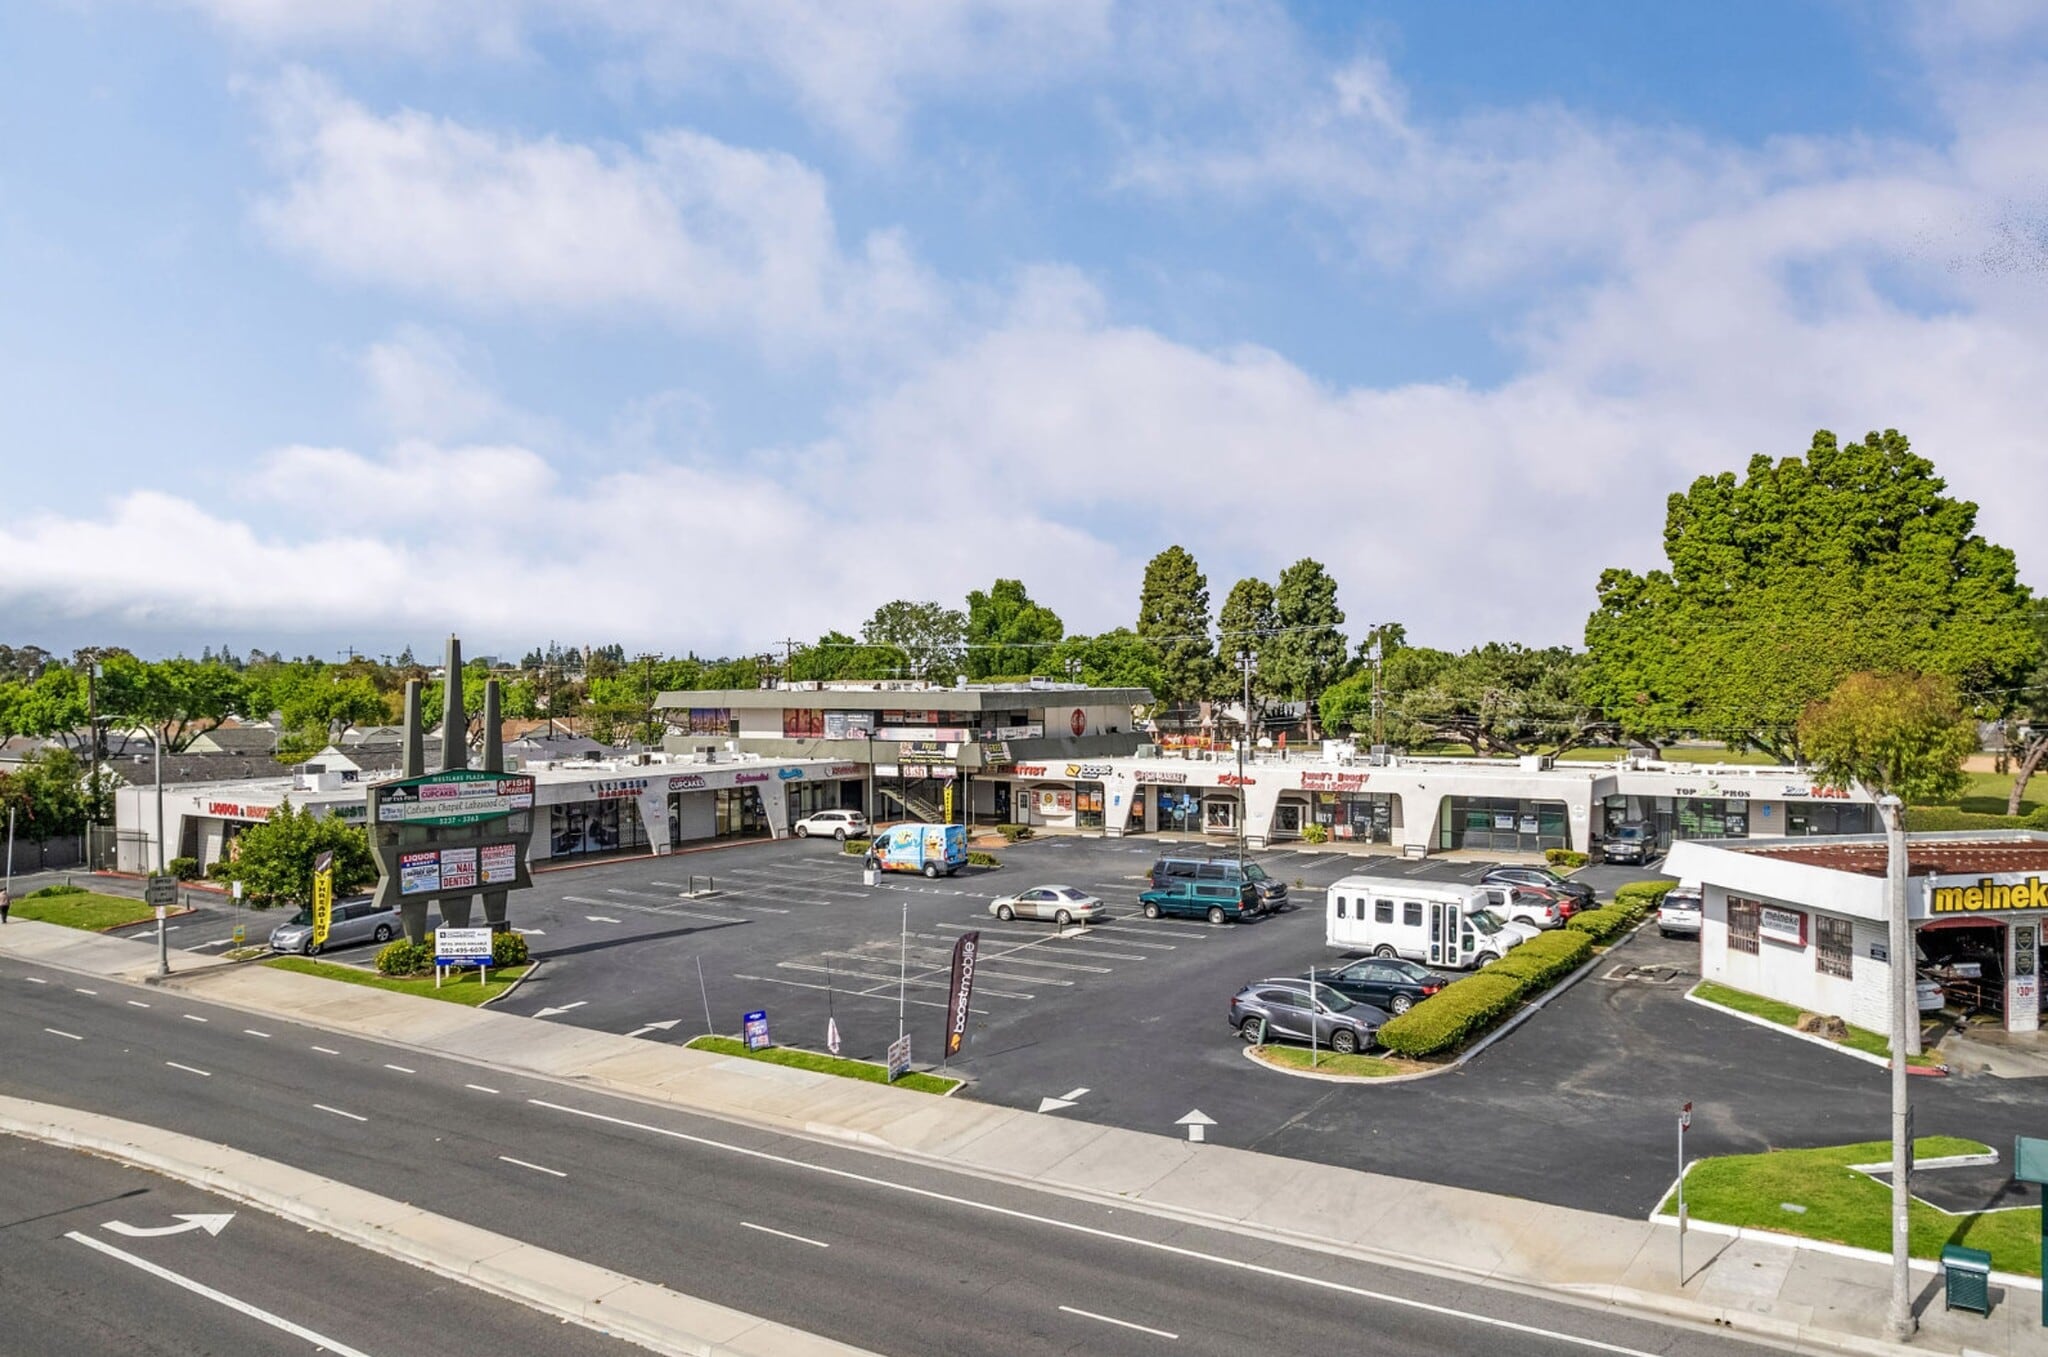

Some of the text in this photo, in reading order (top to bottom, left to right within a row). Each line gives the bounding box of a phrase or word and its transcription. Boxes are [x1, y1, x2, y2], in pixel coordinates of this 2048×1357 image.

[466, 774, 486, 782] PLAZA
[506, 780, 531, 790] FISH
[420, 789, 458, 799] CUPCAKES
[507, 788, 530, 797] MARKET
[1676, 788, 1751, 798] TOP PROS
[209, 802, 239, 815] LIQUOR
[438, 799, 463, 813] Chapel
[464, 796, 498, 811] Lakewood
[403, 852, 436, 863] LIQUOR
[456, 863, 476, 873] NAIL
[443, 875, 475, 888] DENTIST
[317, 880, 326, 937] THREADING
[1764, 910, 1799, 926] meineke
[953, 941, 975, 1033] boostmobile
